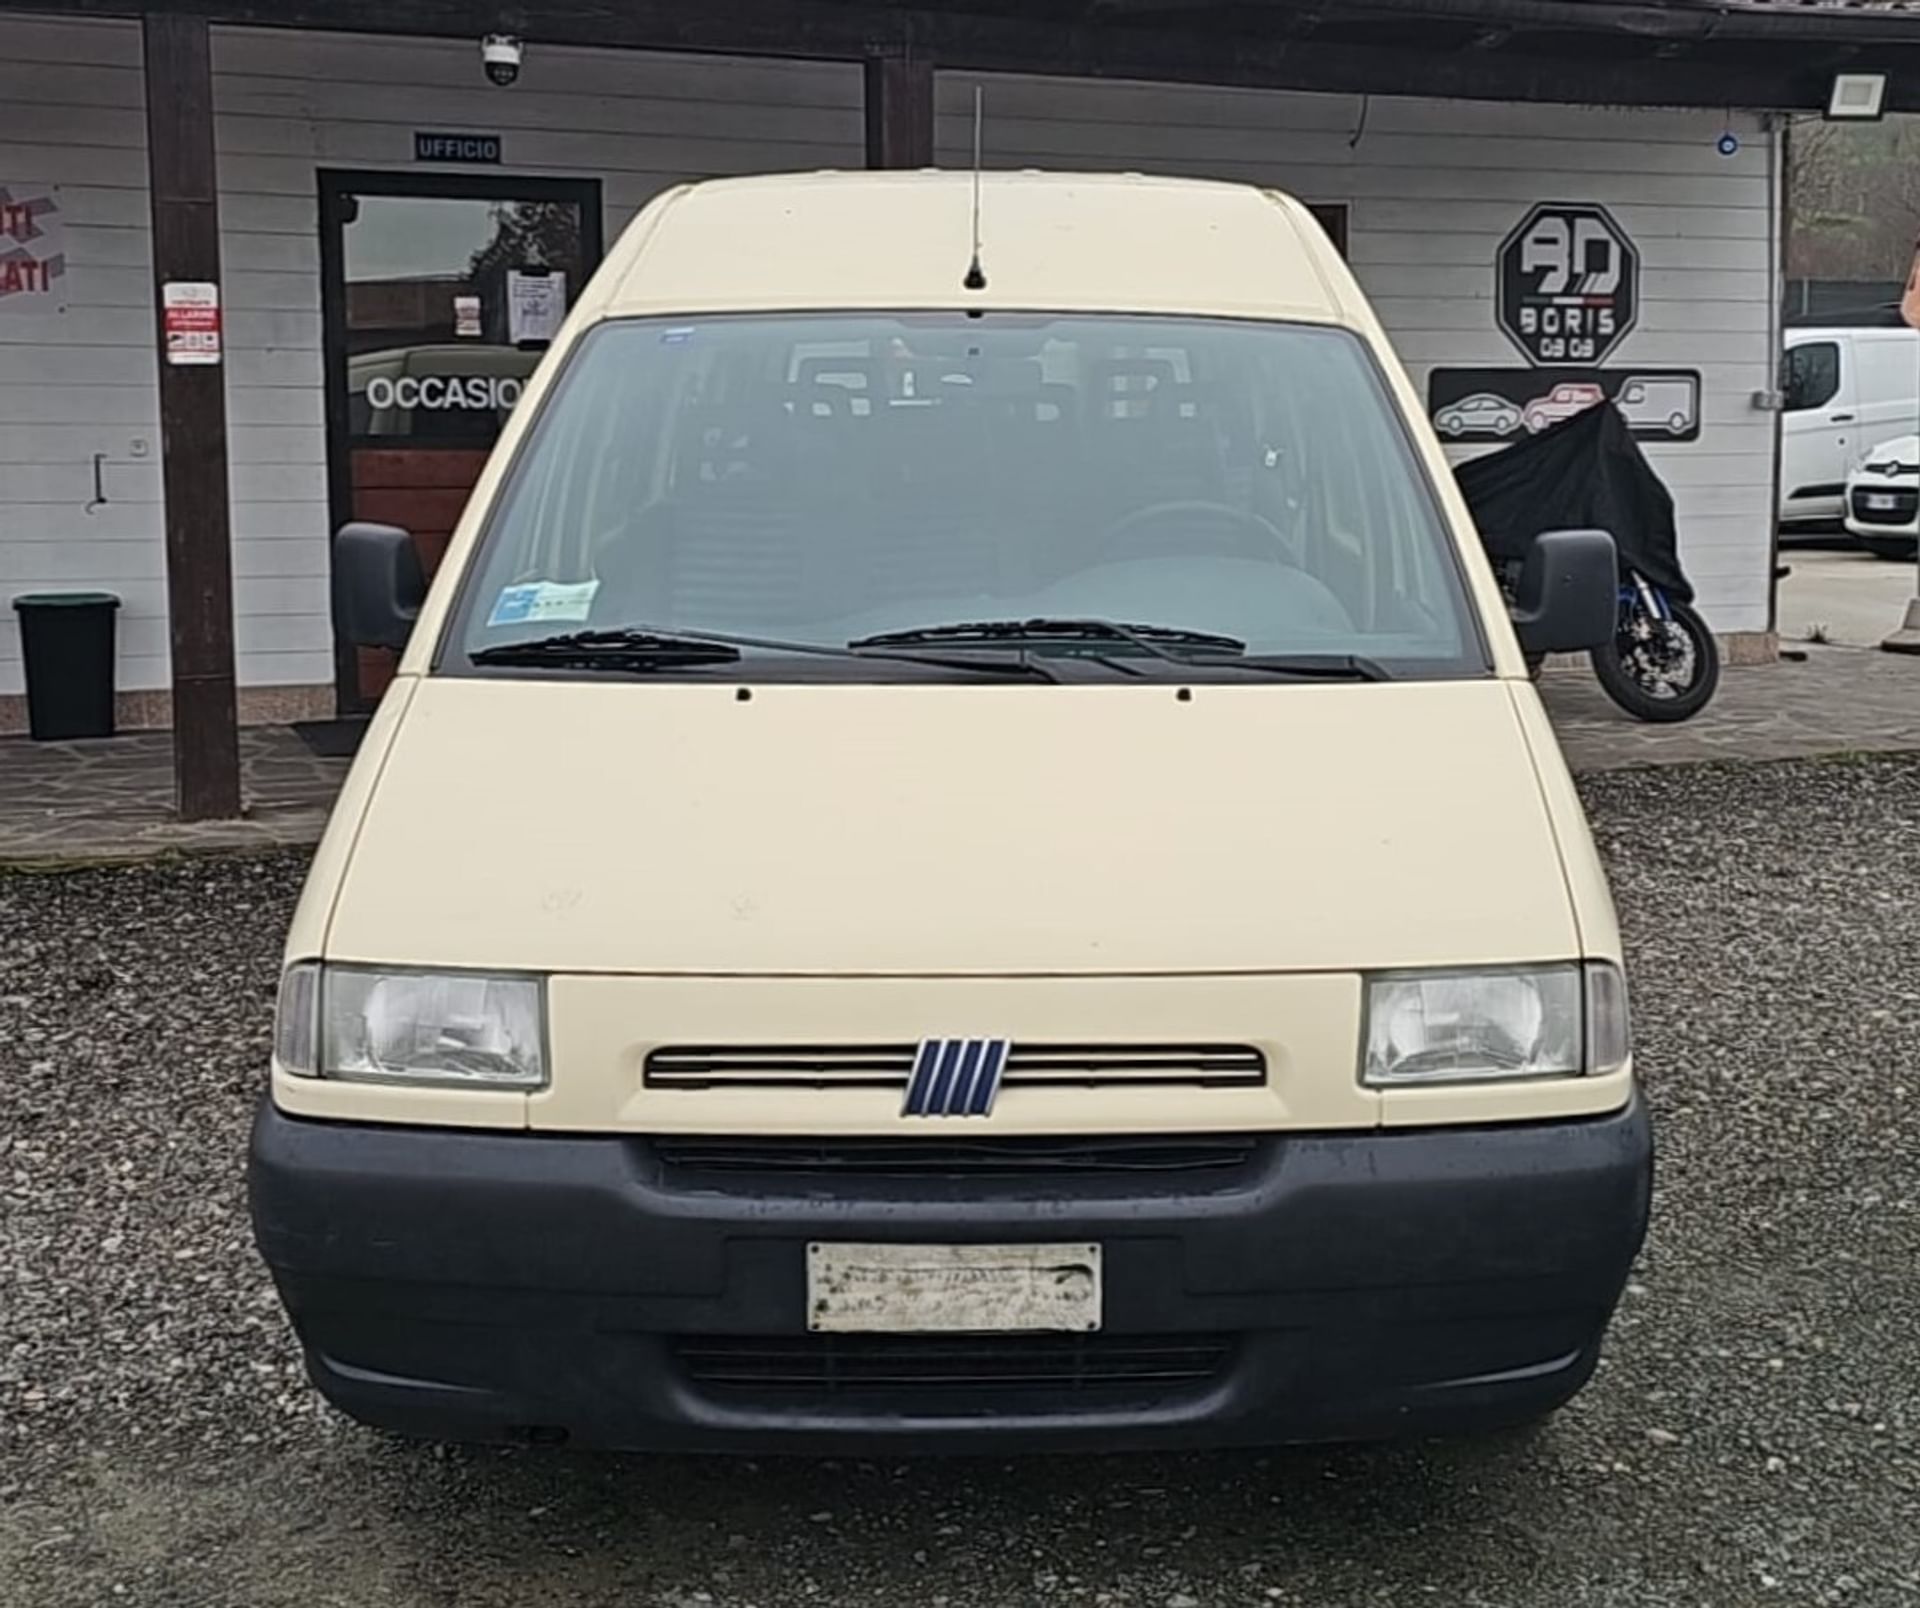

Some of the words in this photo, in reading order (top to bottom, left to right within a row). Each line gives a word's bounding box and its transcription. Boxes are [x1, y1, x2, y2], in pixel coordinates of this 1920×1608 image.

[420, 139, 497, 159] UFFICIO
[0, 204, 32, 234] TI
[1520, 307, 1615, 335] BORIS
[366, 377, 531, 409] OCCASIO
